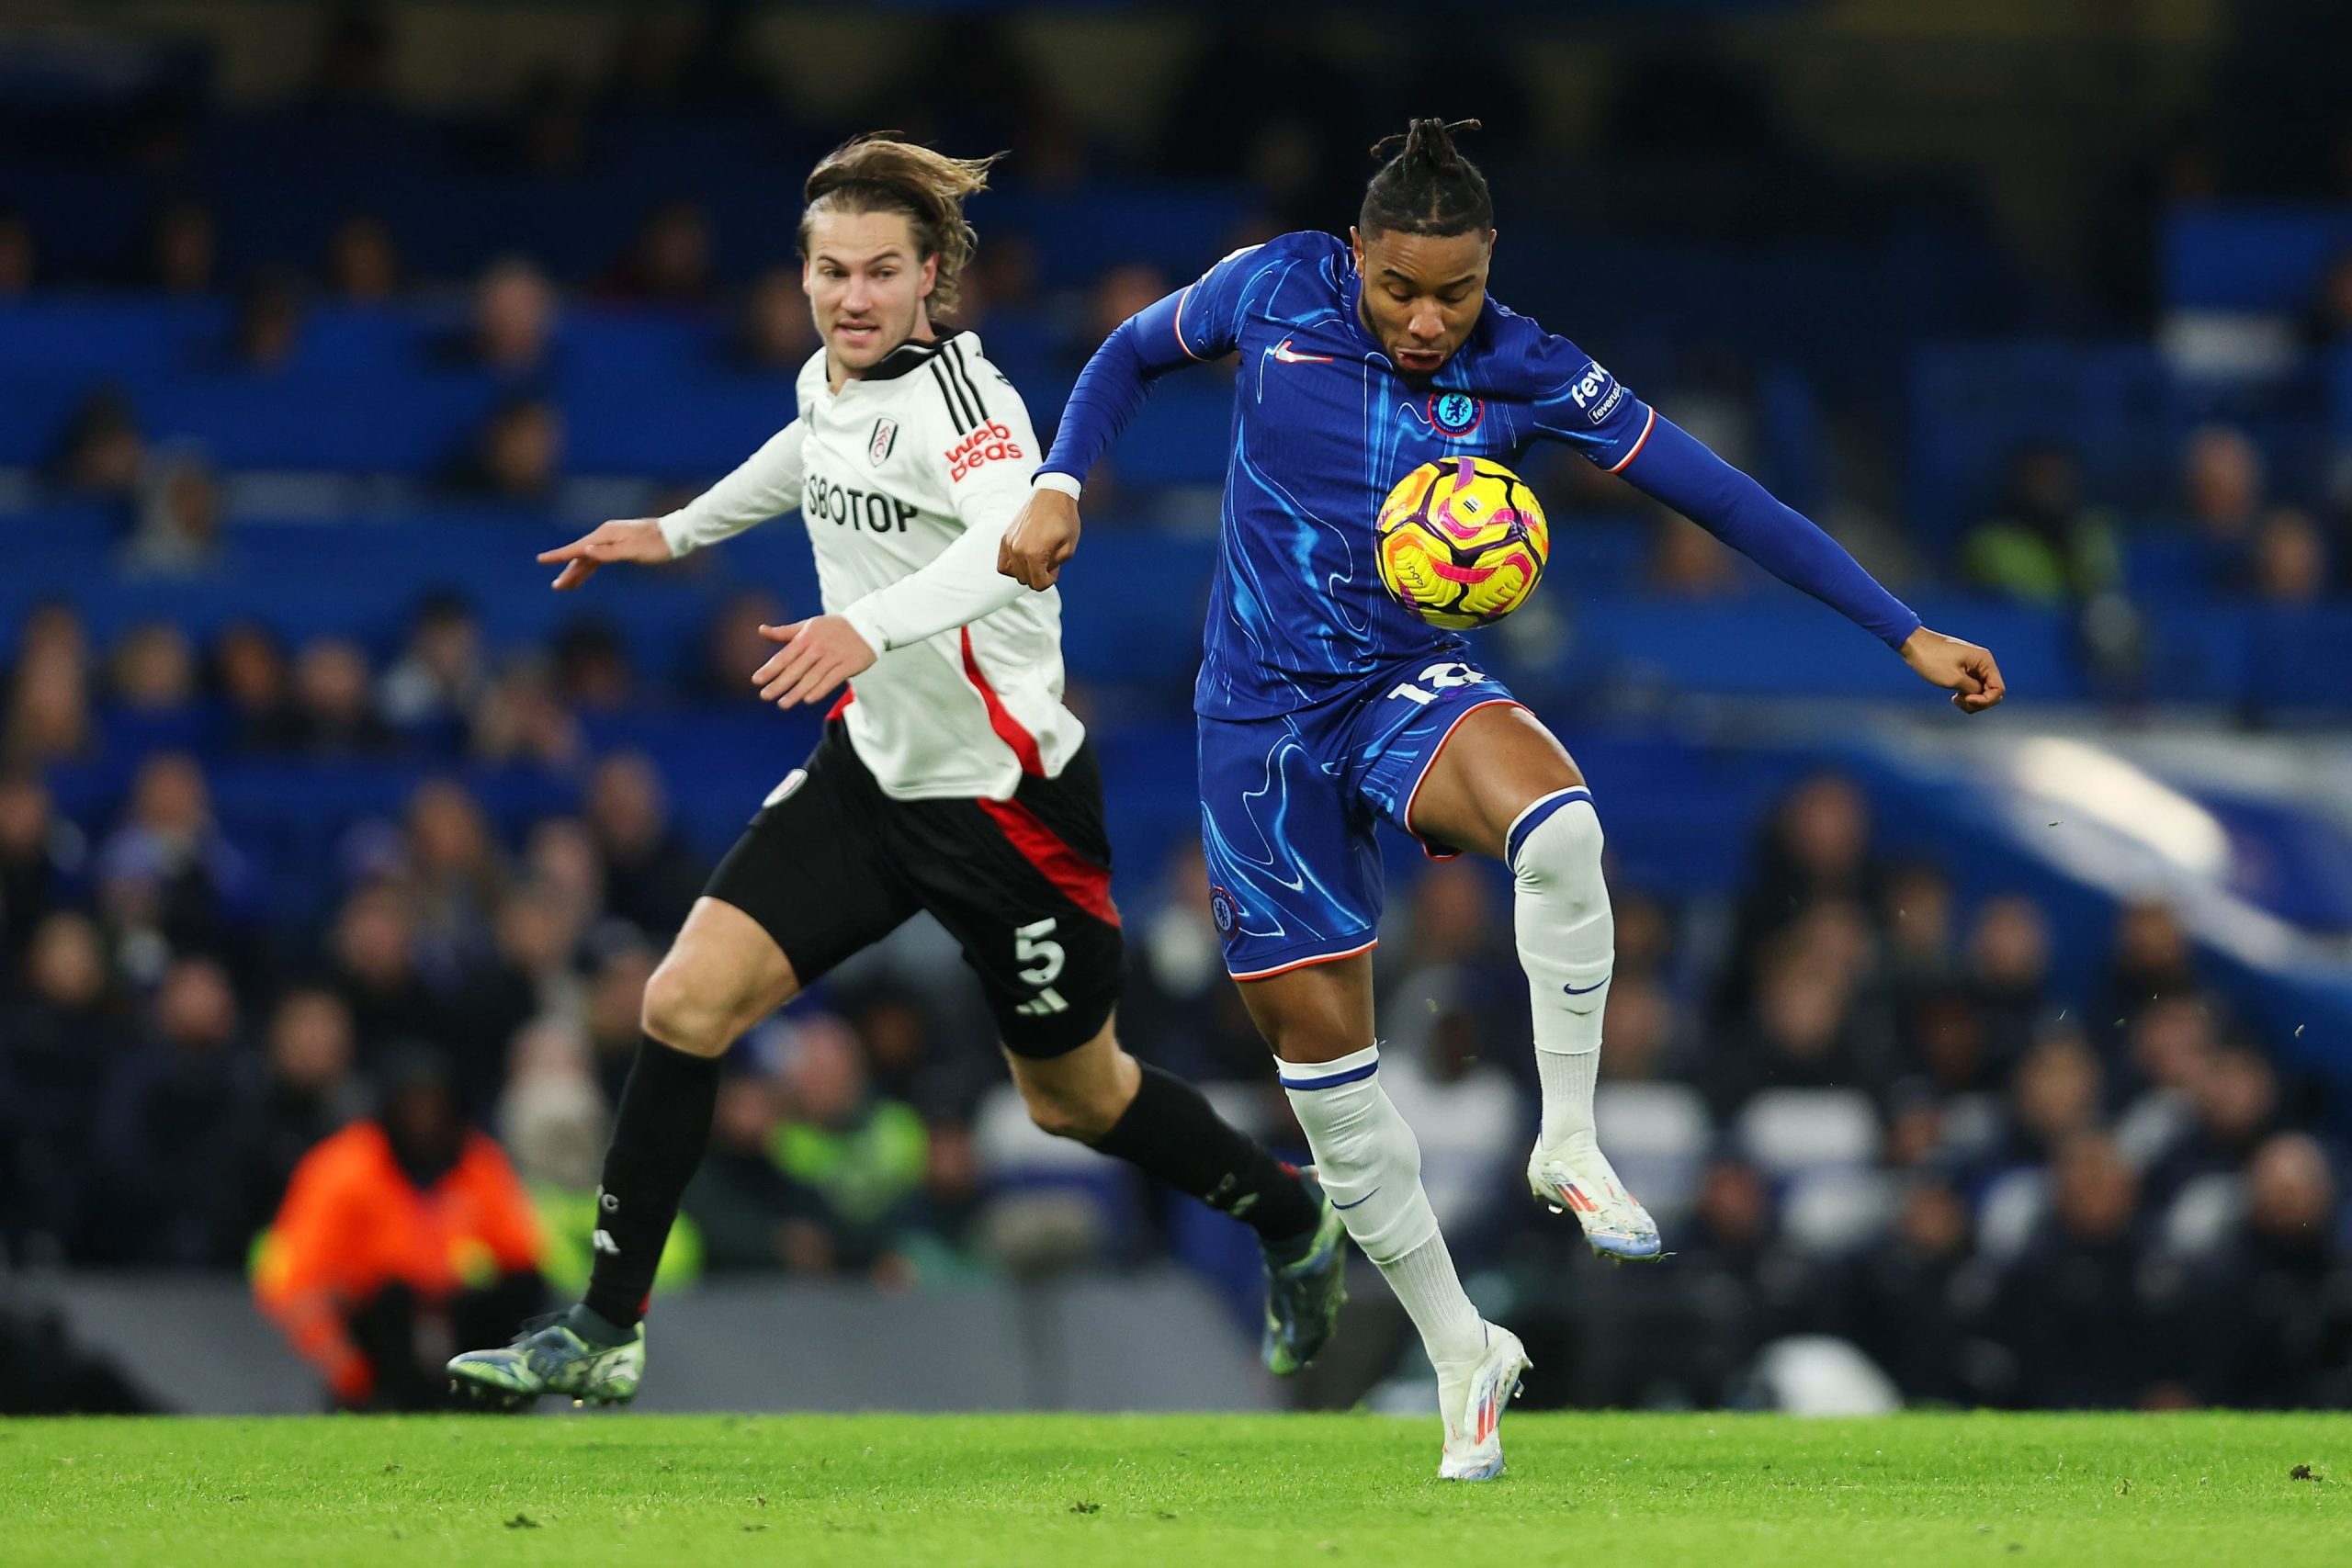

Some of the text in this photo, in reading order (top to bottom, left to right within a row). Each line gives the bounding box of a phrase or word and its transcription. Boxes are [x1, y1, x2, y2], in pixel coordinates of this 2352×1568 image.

[944, 419, 1011, 463] web
[808, 473, 919, 533] SBOTOP
[1014, 917, 1066, 986] 5
